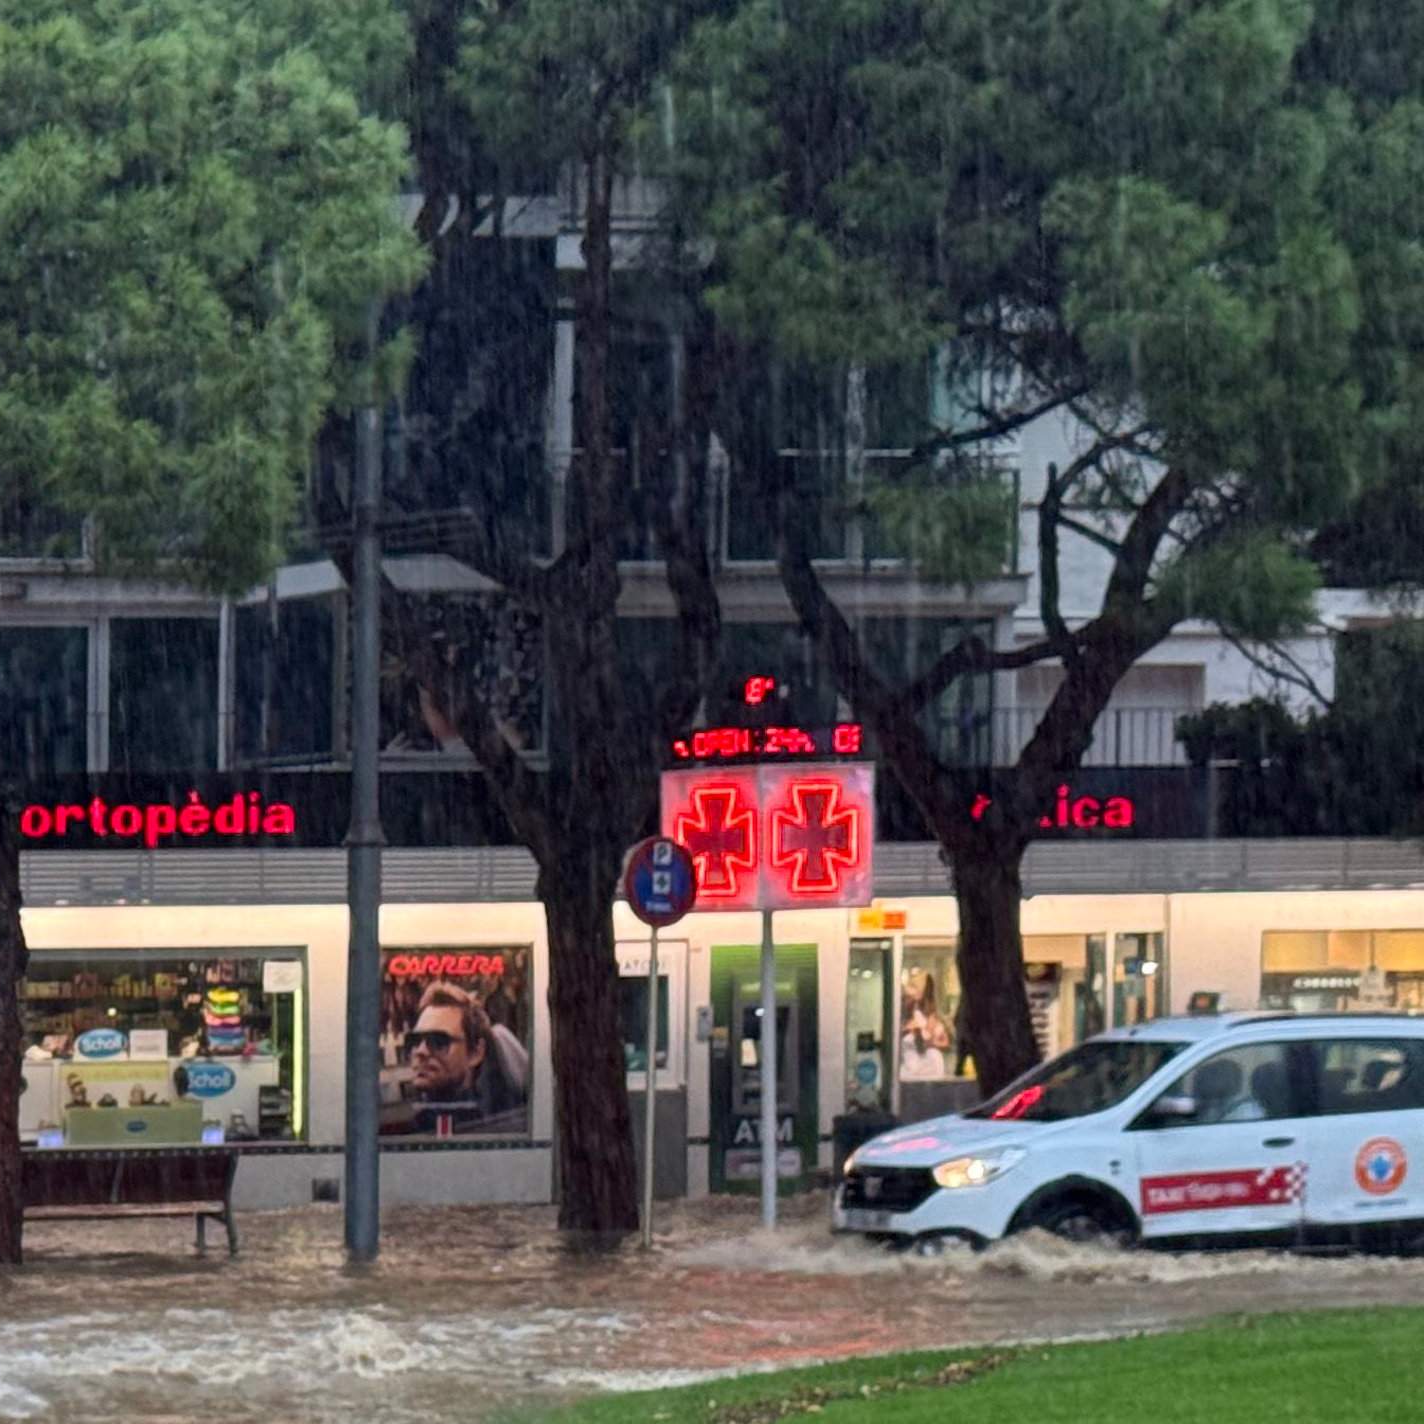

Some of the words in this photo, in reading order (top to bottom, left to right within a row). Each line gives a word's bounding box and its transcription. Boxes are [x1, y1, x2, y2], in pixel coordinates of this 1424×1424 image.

[20, 790, 296, 849] ortopèdia
[388, 953, 504, 976] CARRERA
[82, 1035, 125, 1050] Scholl
